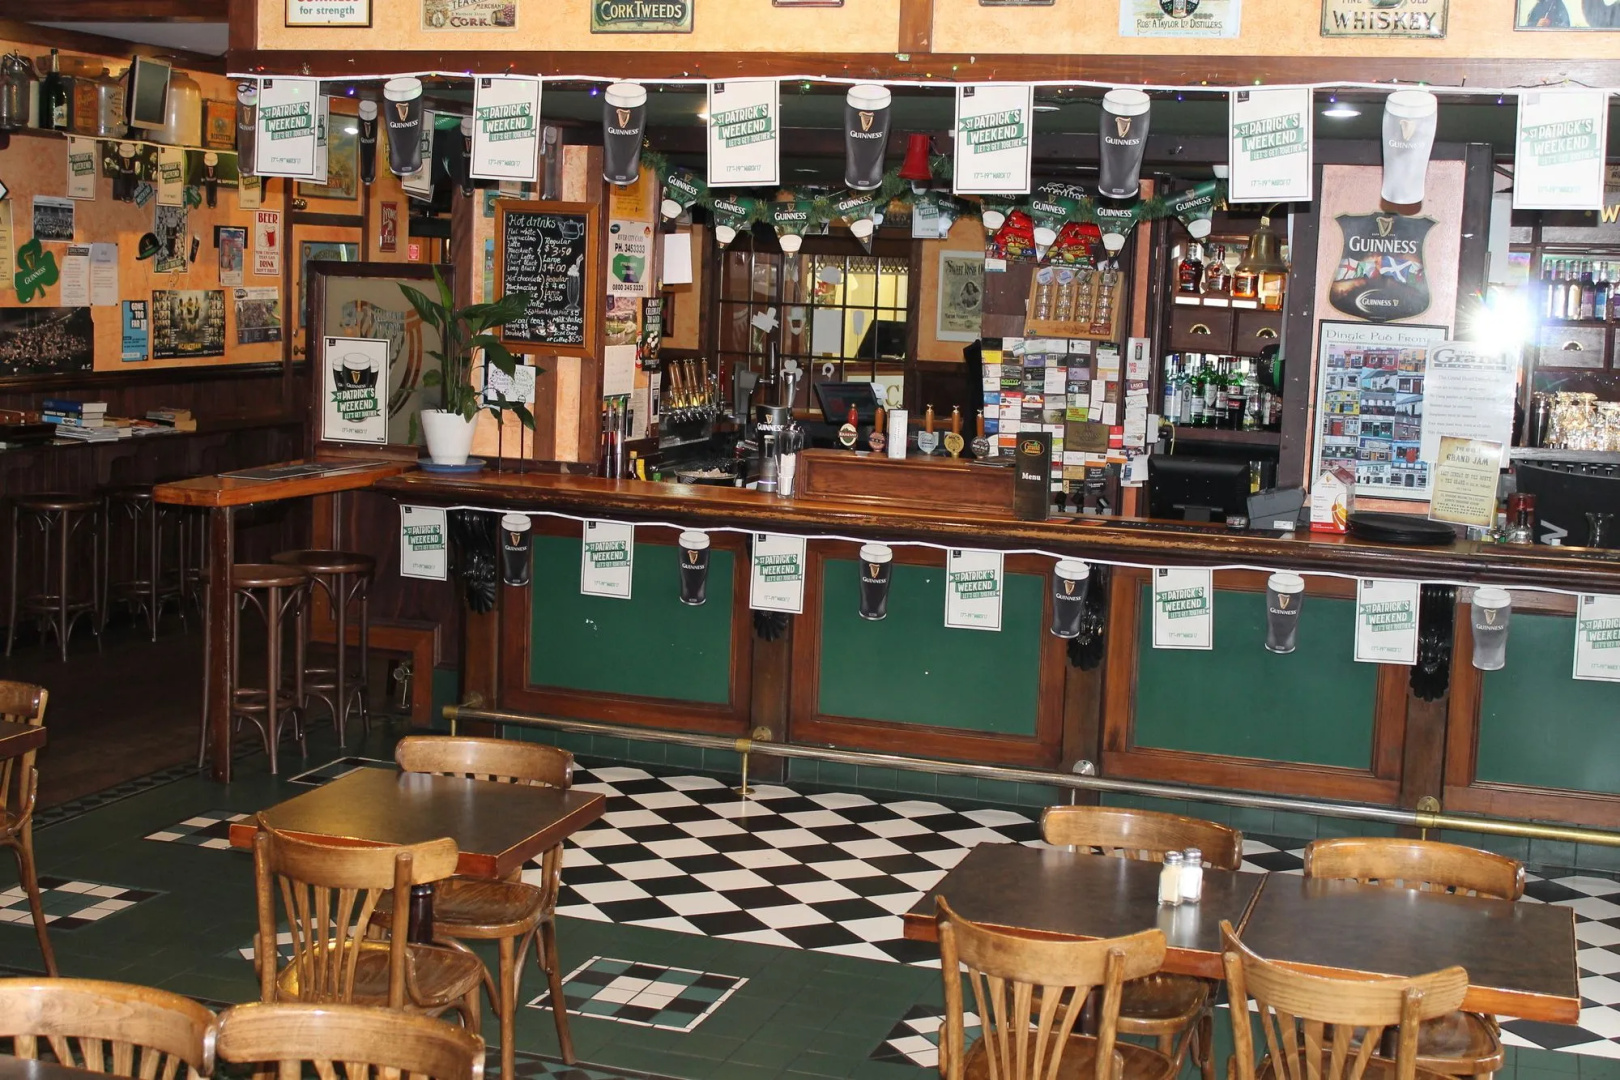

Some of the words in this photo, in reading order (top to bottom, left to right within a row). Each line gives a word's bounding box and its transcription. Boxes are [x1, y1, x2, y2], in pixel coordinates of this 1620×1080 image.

[300, 6, 313, 15] for
[317, 6, 355, 18] strength
[601, 0, 634, 20] CORK
[635, 0, 682, 18] TWEEDS
[1158, 19, 1179, 29] TAYLOR
[1333, 10, 1437, 30] WHISKEY
[265, 109, 272, 117] ST
[483, 109, 489, 117] ST
[717, 114, 725, 123] ST
[268, 116, 307, 131] WEEKEND
[390, 119, 419, 128] GUINNESS
[486, 118, 528, 132] WEEKEND
[722, 120, 765, 138] WEEKEND
[966, 119, 974, 129] ST
[607, 126, 639, 136] GUINNESS
[850, 130, 883, 139] GUINNESS
[970, 125, 1017, 144] WEEKEND
[1241, 125, 1249, 134] ST
[1105, 136, 1140, 146] GUINNESS
[1245, 130, 1297, 150] WEEKEND
[1534, 136, 1590, 156] WEEKEND
[667, 175, 699, 195] GUINNESS
[714, 199, 746, 215] GUINNESS
[838, 195, 872, 211] GUINNESS
[1032, 200, 1067, 215] GUINNESS
[1175, 196, 1211, 212] GUINNESS
[258, 212, 278, 224] BEER
[774, 212, 806, 221] GUINNESS
[1097, 207, 1132, 218] GUINNESS
[508, 214, 525, 228] Hot
[526, 216, 556, 228] drinks
[545, 237, 571, 248] Regular
[1349, 235, 1417, 254] GUINNESS
[543, 254, 561, 266] Large
[1361, 297, 1391, 307] GUINNESS
[1325, 329, 1365, 341] Dingle
[1369, 330, 1392, 342] Pub
[340, 399, 373, 411] WEEKEND
[1446, 453, 1470, 464] GRAND
[1472, 456, 1489, 466] JAM
[1022, 472, 1041, 481] Menu
[410, 535, 439, 544] WEEKEND
[592, 551, 623, 561] WEEKEND
[682, 562, 705, 570] GUINNESS
[762, 564, 795, 574] WEEKEND
[862, 576, 887, 584] GUINNESS
[958, 581, 993, 591] WEEKEND
[1055, 592, 1082, 601] GUINNESS
[1165, 599, 1202, 612] WEEKEND
[1269, 607, 1297, 615] GUINNESS
[1369, 613, 1408, 624] WEEKEND
[1476, 623, 1504, 631] GUINNESS
